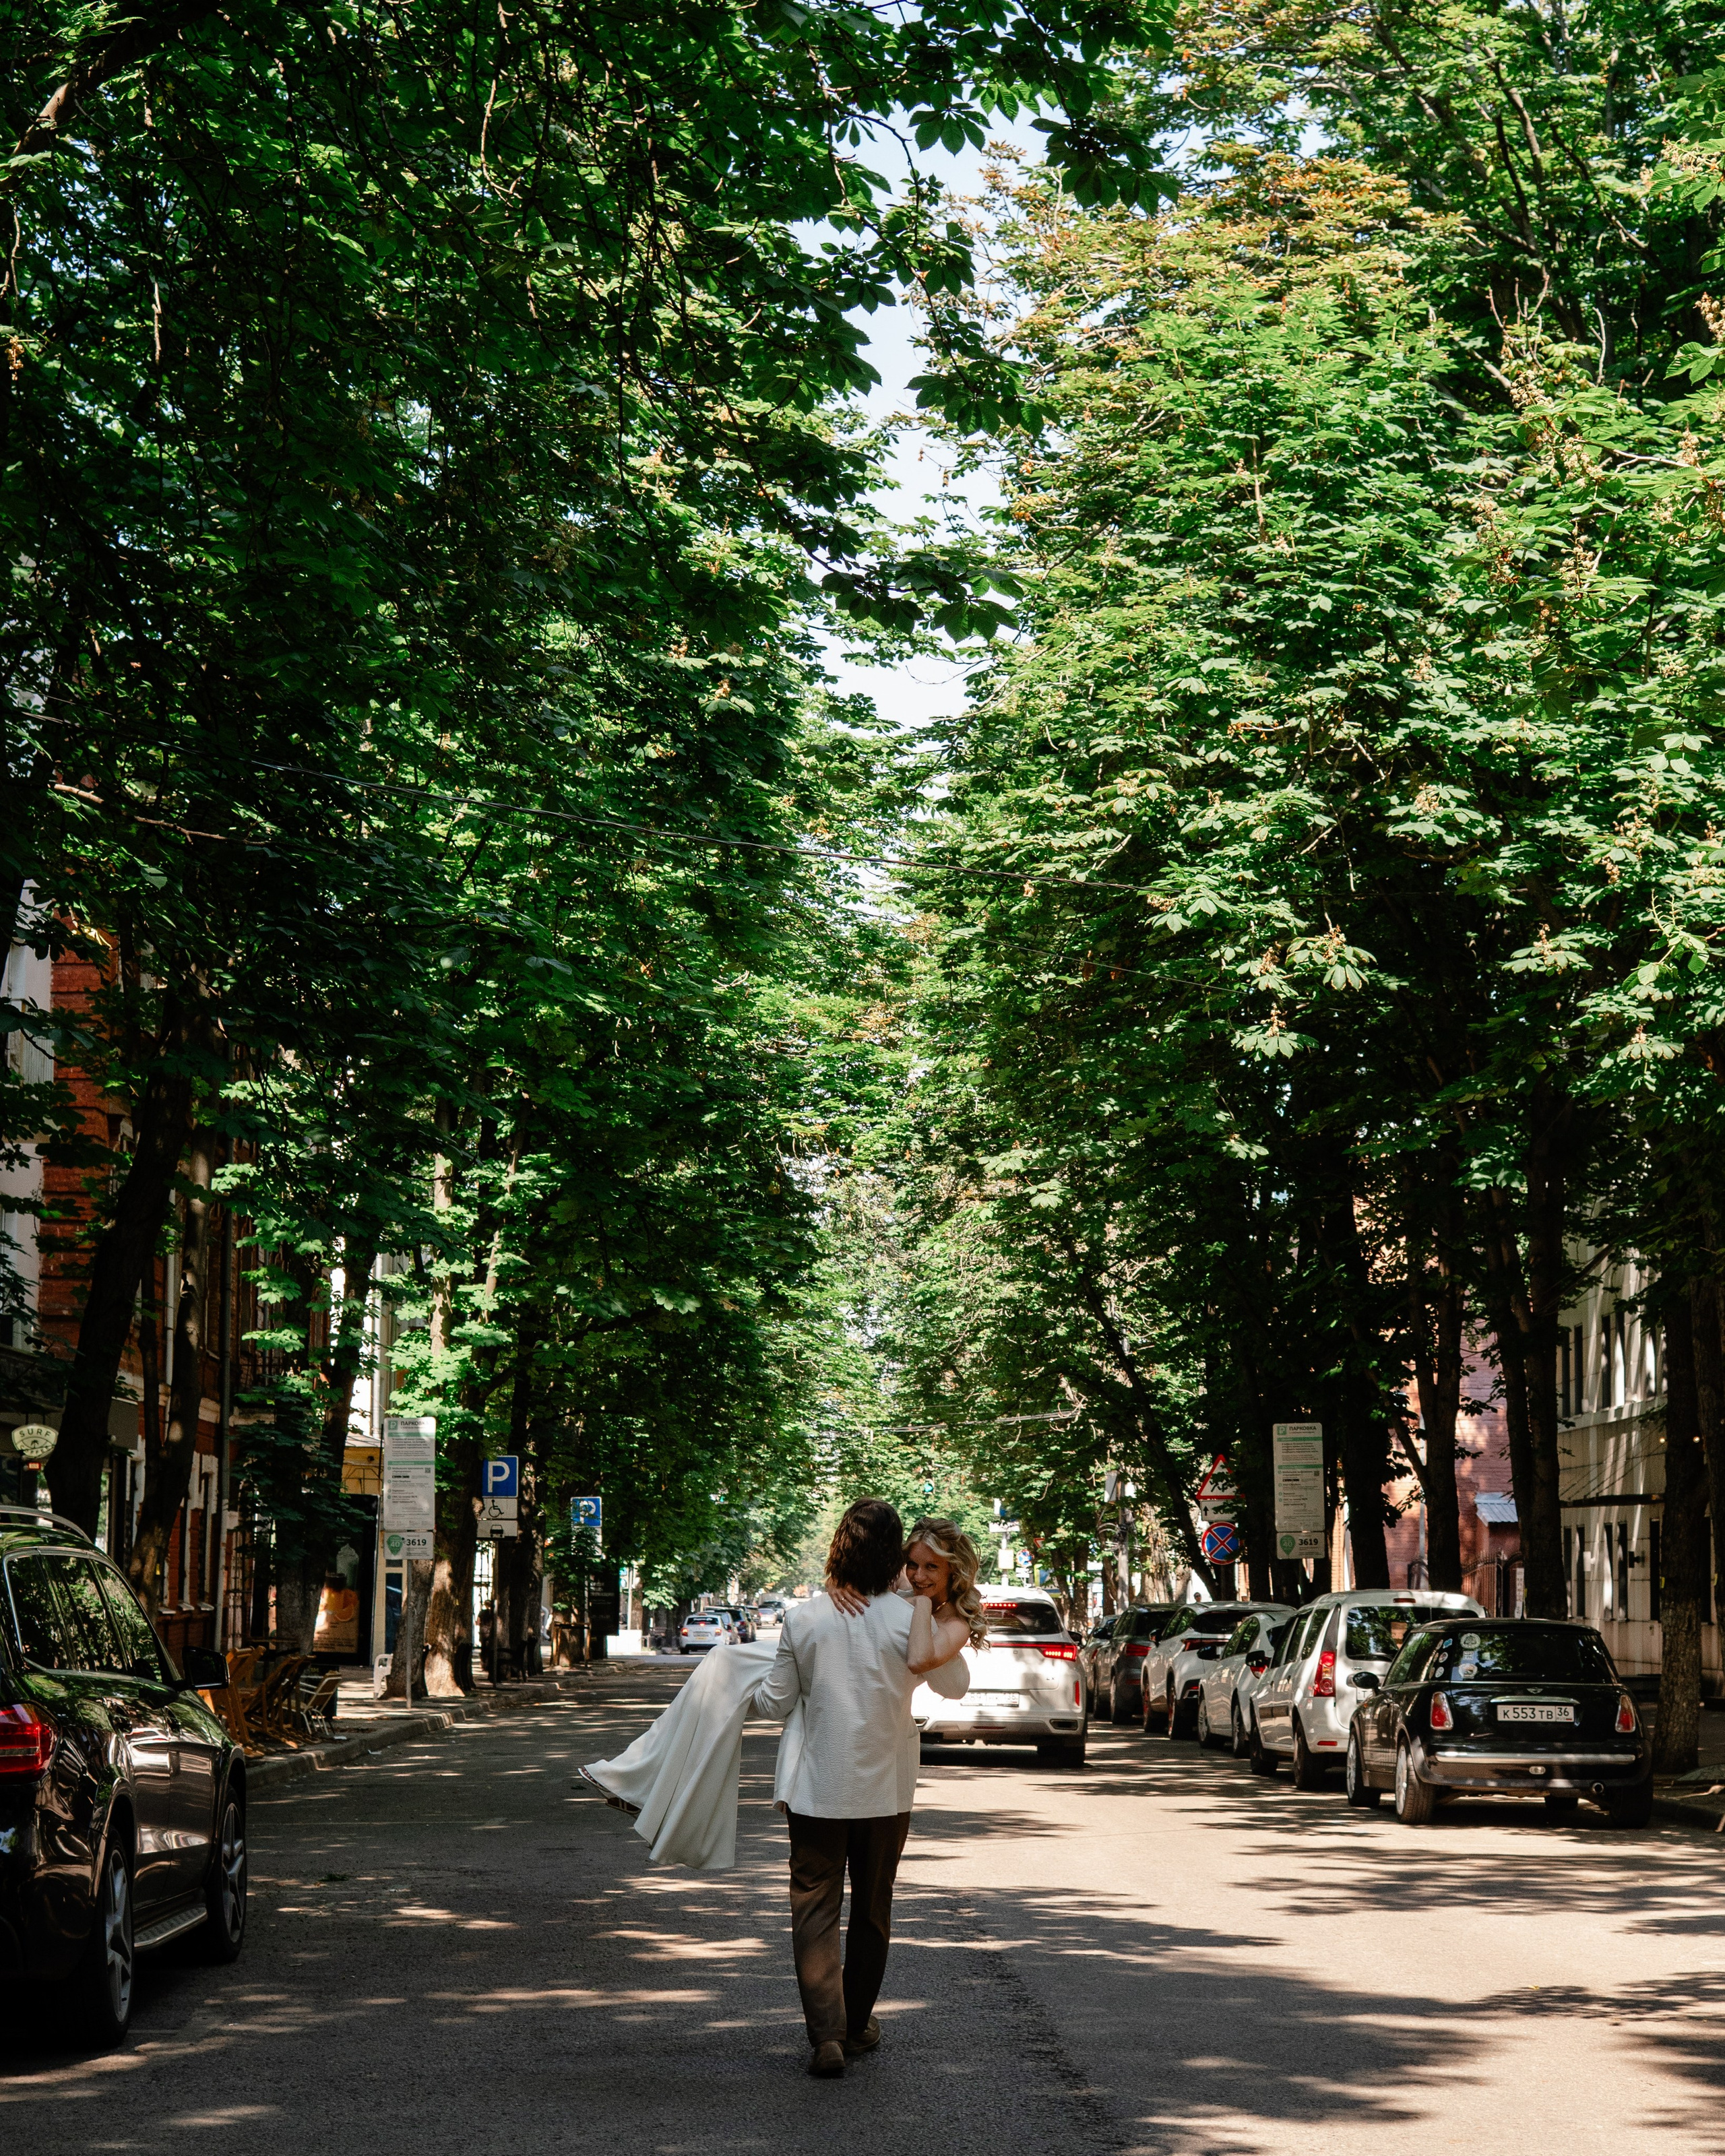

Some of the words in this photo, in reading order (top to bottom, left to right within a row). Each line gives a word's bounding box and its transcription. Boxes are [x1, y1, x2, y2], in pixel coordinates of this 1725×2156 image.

[19, 1428, 51, 1437] SURF
[488, 1461, 510, 1492] P
[1557, 1707, 1569, 1716] 36
